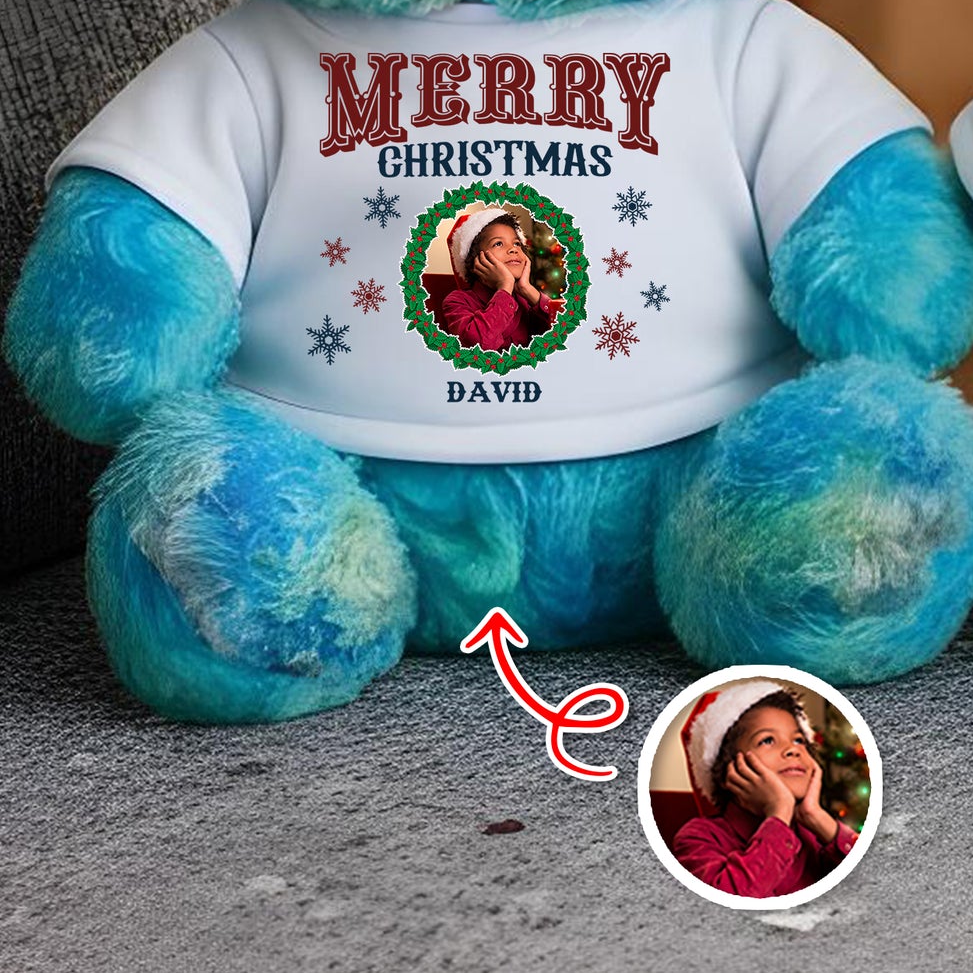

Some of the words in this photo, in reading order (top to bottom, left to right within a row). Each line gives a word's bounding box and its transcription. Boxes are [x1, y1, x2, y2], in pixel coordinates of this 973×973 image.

[320, 52, 671, 158] MERRY
[377, 139, 614, 178] CHRISTMAS
[446, 381, 543, 403] DAVID
